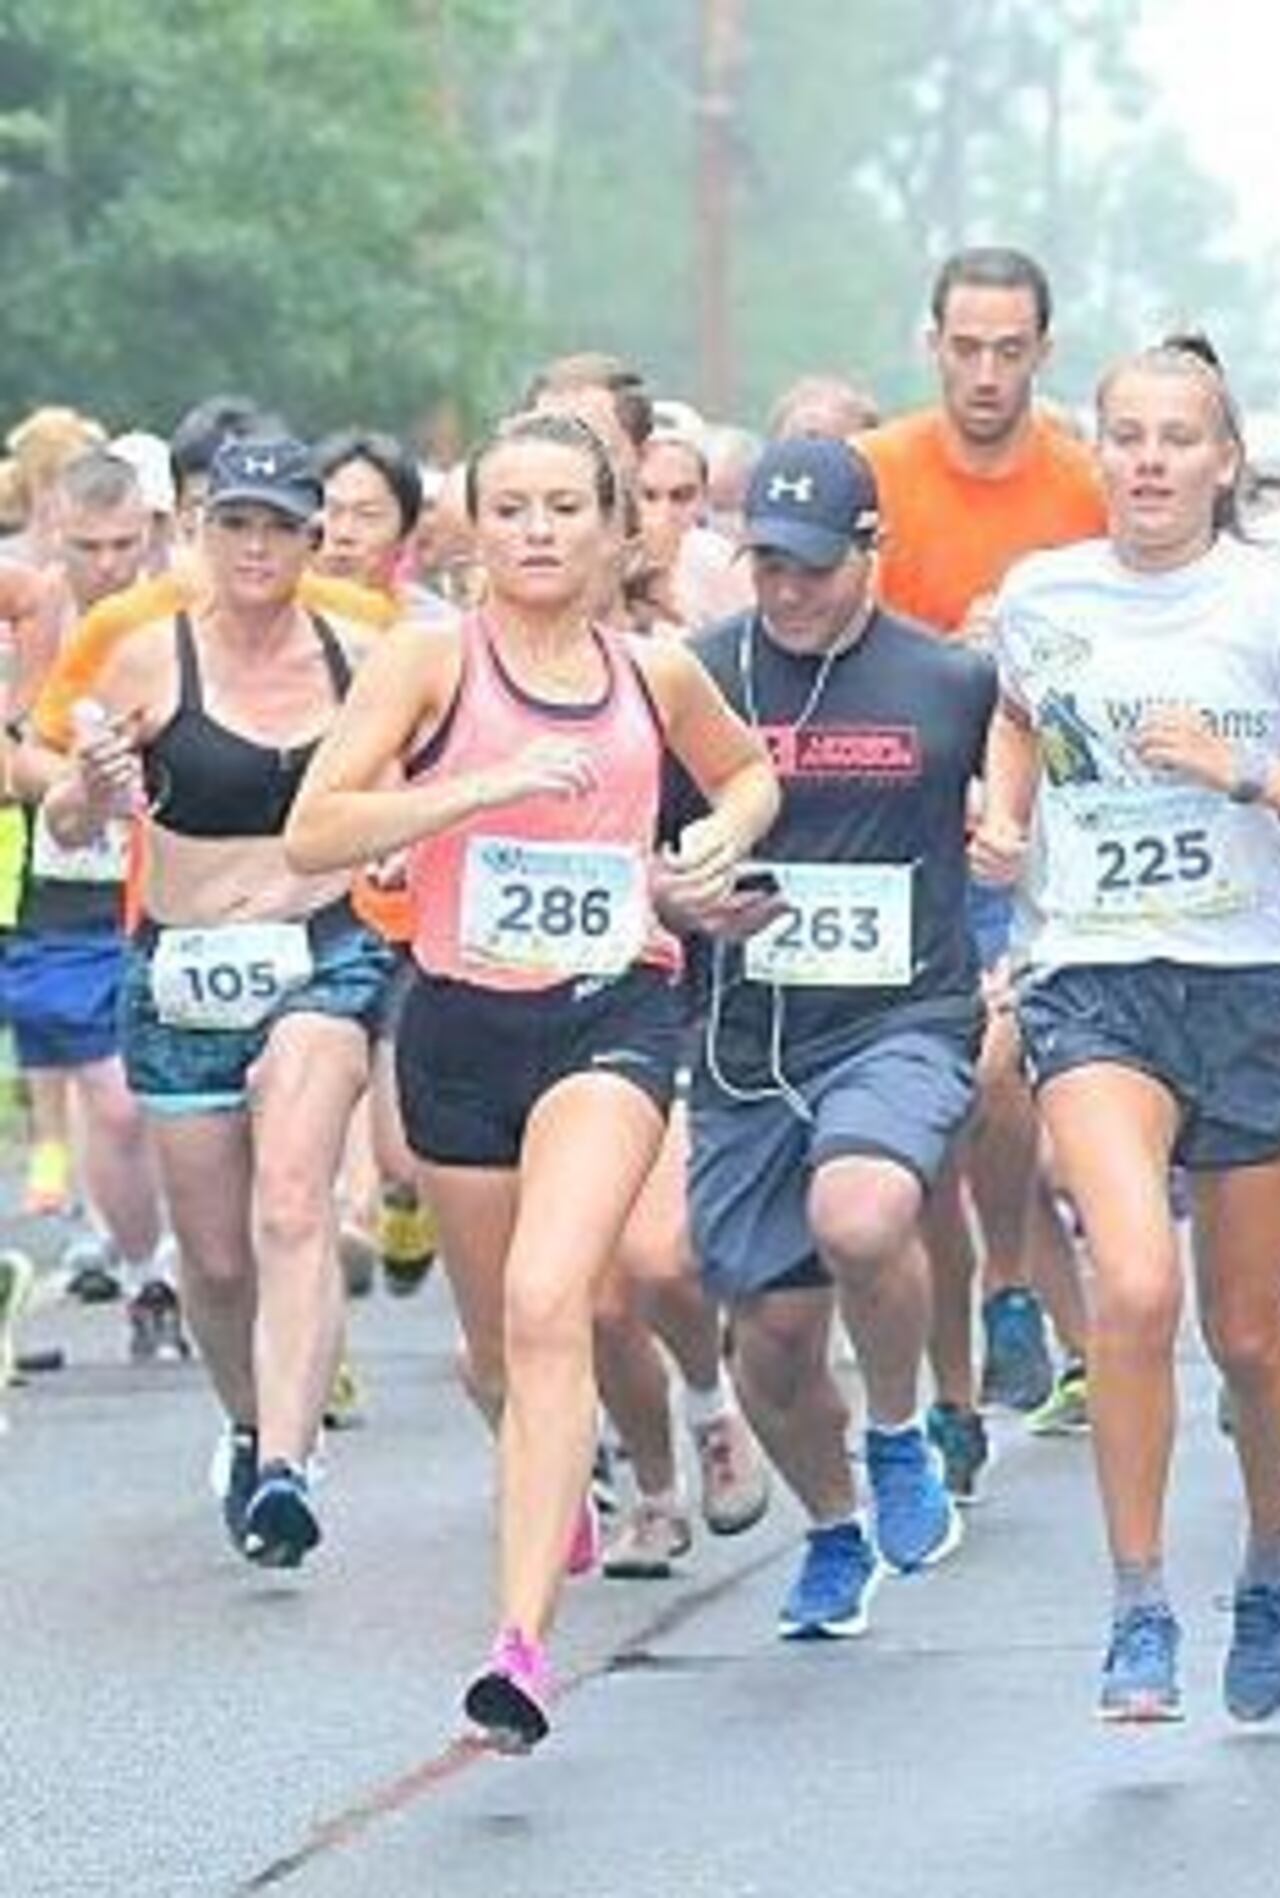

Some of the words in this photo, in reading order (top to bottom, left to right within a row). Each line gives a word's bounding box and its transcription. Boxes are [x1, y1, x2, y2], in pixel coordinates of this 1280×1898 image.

[1096, 830, 1214, 892] 225
[496, 883, 611, 937] 286
[773, 907, 881, 952] 263
[181, 961, 278, 1003] 105
